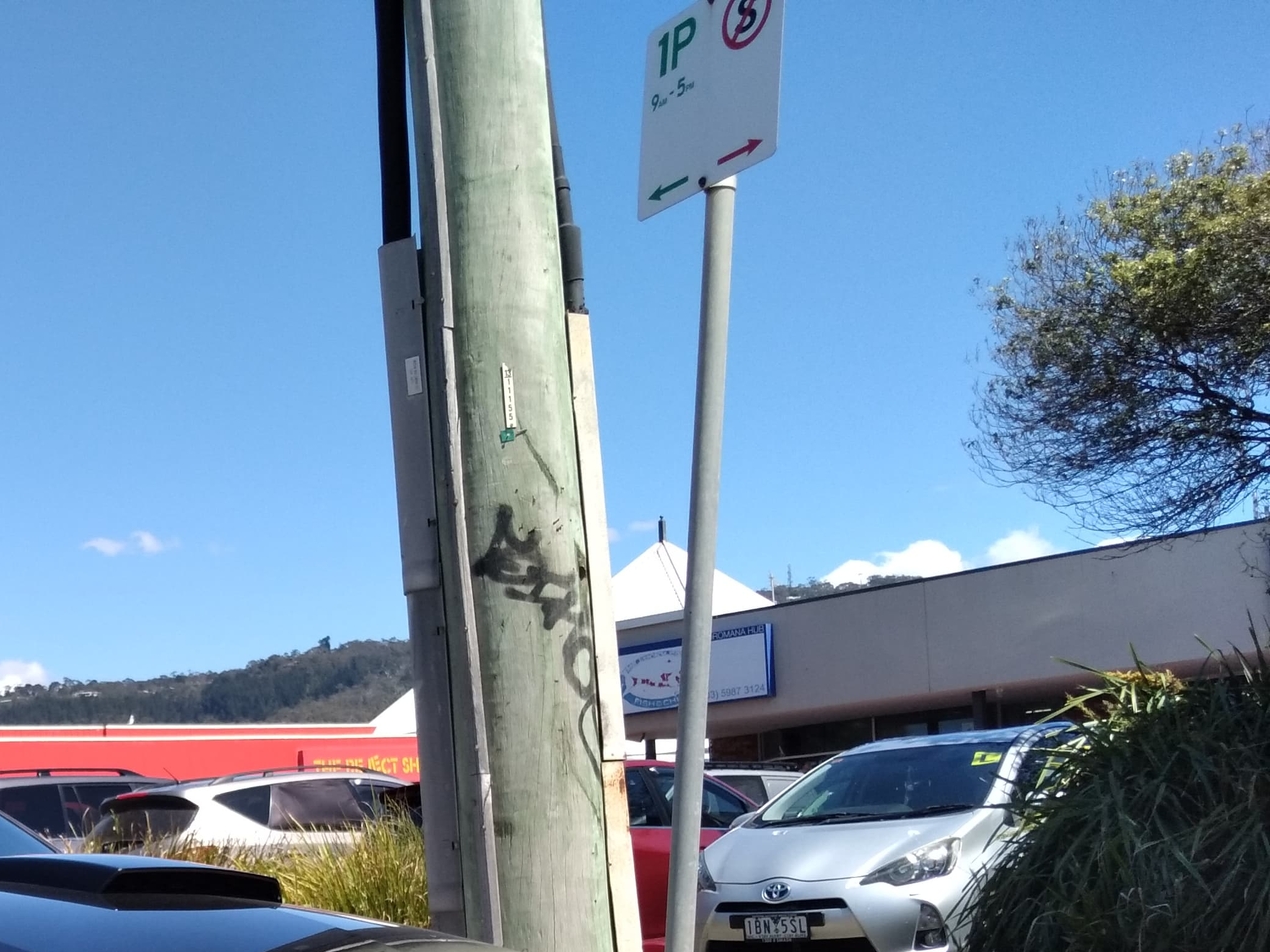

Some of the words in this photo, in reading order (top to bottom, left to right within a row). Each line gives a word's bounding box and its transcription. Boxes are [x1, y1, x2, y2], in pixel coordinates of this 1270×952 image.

[658, 17, 696, 78] 1P
[711, 628, 746, 640] ROMANA
[747, 624, 765, 634] HUB
[721, 686, 741, 697] 5987
[744, 683, 765, 694] 3124
[402, 757, 420, 774] SH
[747, 919, 771, 935] 1BN
